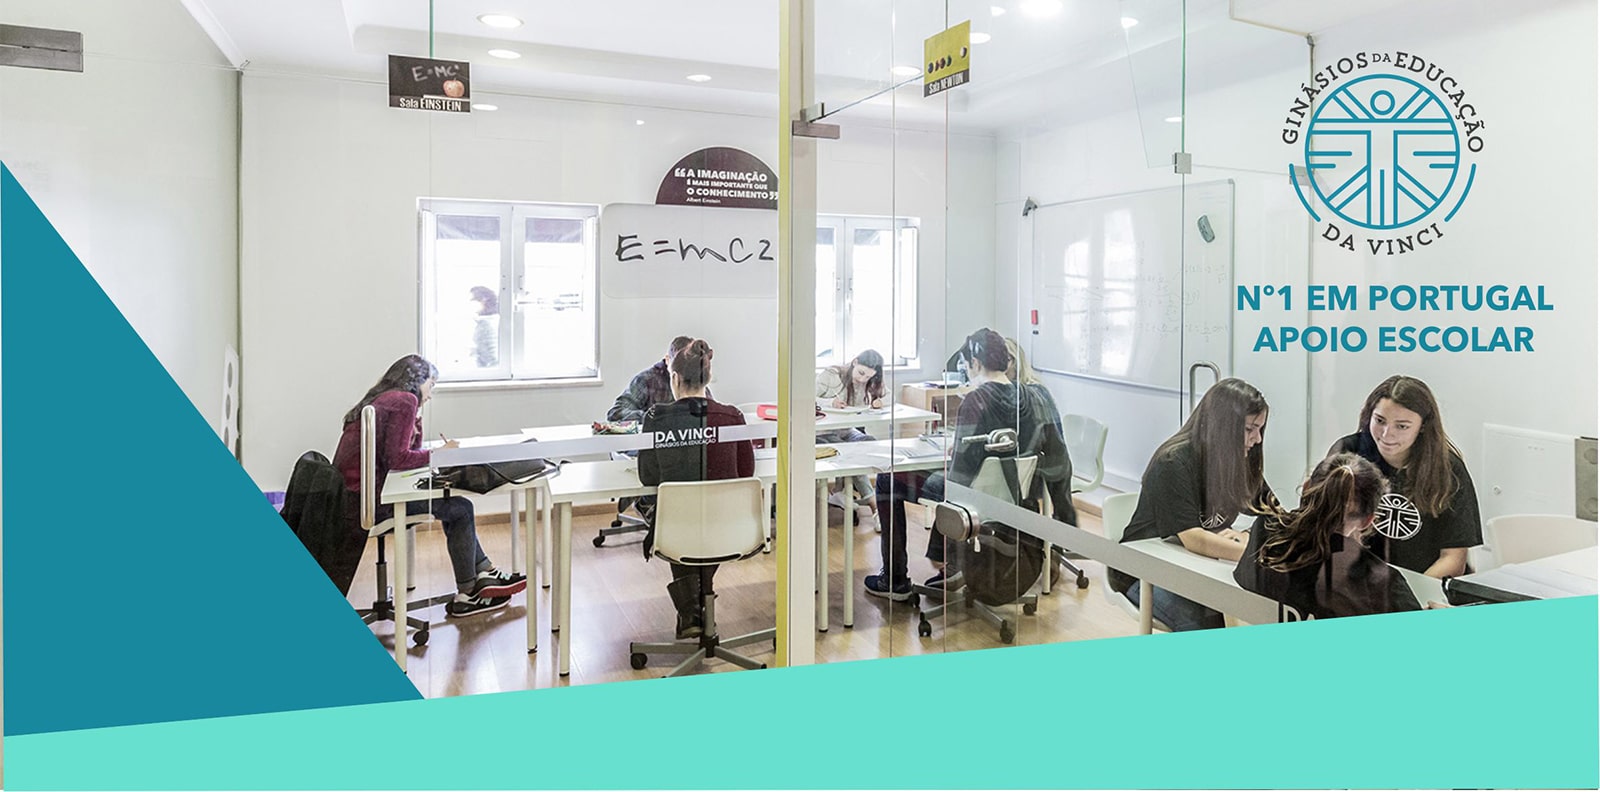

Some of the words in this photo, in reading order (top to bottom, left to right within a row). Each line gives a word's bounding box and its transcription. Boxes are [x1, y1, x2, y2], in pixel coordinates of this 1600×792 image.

[399, 97, 419, 109] Sala
[420, 98, 462, 112] EINSTEIN
[697, 169, 768, 183] IMAGINAÇÃO
[692, 179, 710, 187] MAIS
[711, 181, 753, 189] IMPORTANTE
[686, 187, 695, 195] O
[655, 430, 676, 443] DA
[678, 426, 717, 441] VINCI
[655, 441, 680, 449] GINÁSIOS
[688, 438, 717, 446] EDUCAÇÃO
